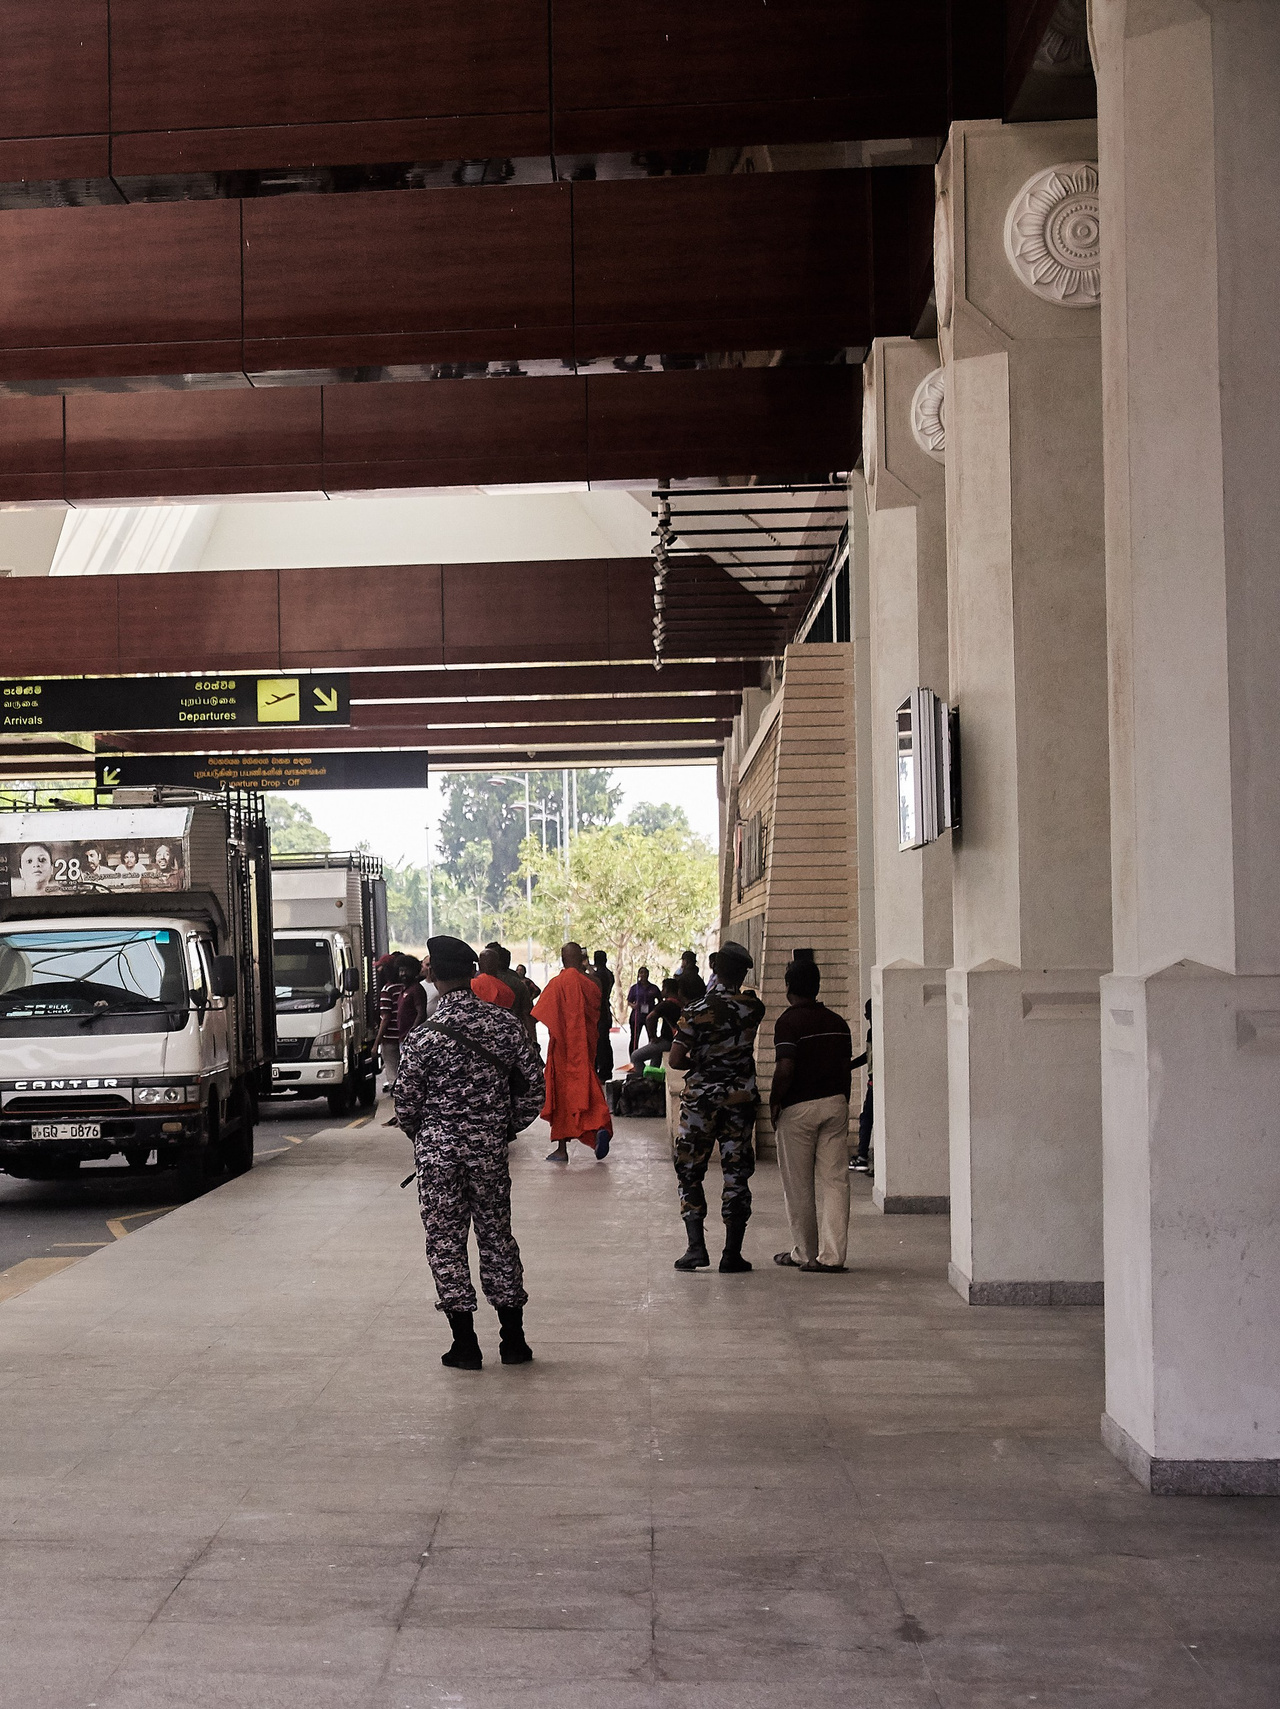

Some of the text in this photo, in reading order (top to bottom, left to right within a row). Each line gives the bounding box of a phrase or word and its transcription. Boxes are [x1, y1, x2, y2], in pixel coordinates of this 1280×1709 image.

[3, 700, 39, 710] வருகை
[180, 696, 236, 707] புறப்படுகை
[4, 716, 43, 725] Arrivals
[179, 711, 237, 723] Departures
[220, 779, 258, 789] Dparture
[261, 779, 281, 789] Drop
[288, 778, 301, 787] Off
[54, 858, 81, 881] 28
[14, 1078, 119, 1090] CANTER
